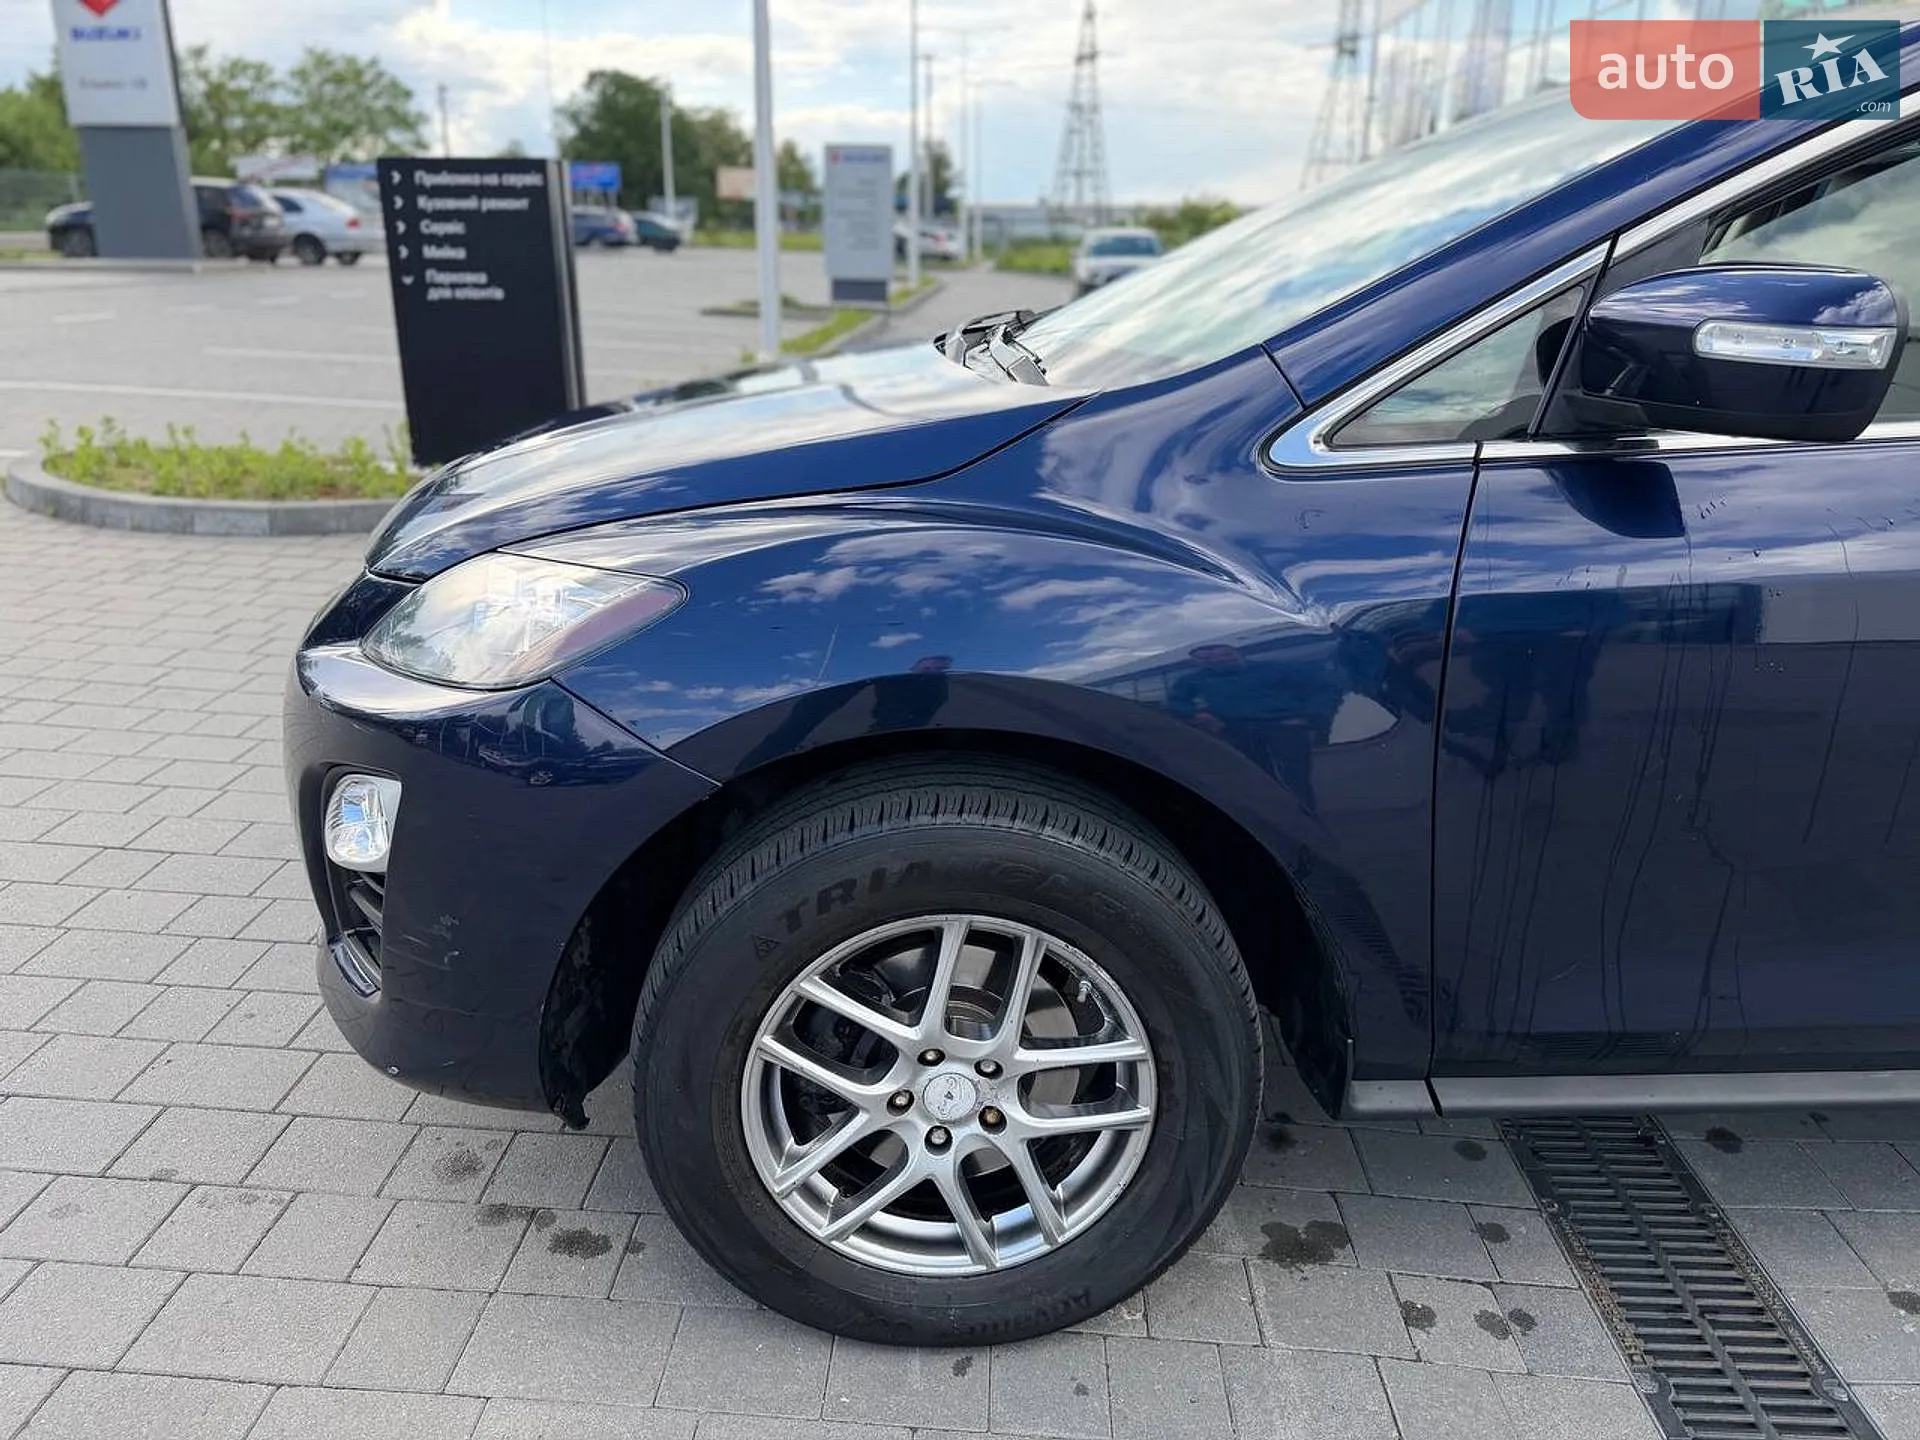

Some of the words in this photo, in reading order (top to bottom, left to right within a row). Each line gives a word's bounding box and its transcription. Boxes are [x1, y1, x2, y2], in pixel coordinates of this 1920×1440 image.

[482, 173, 500, 186] на
[481, 198, 530, 213] ремонт
[420, 219, 466, 236] Сервіс
[422, 244, 467, 260] Мийка
[427, 287, 453, 301] для
